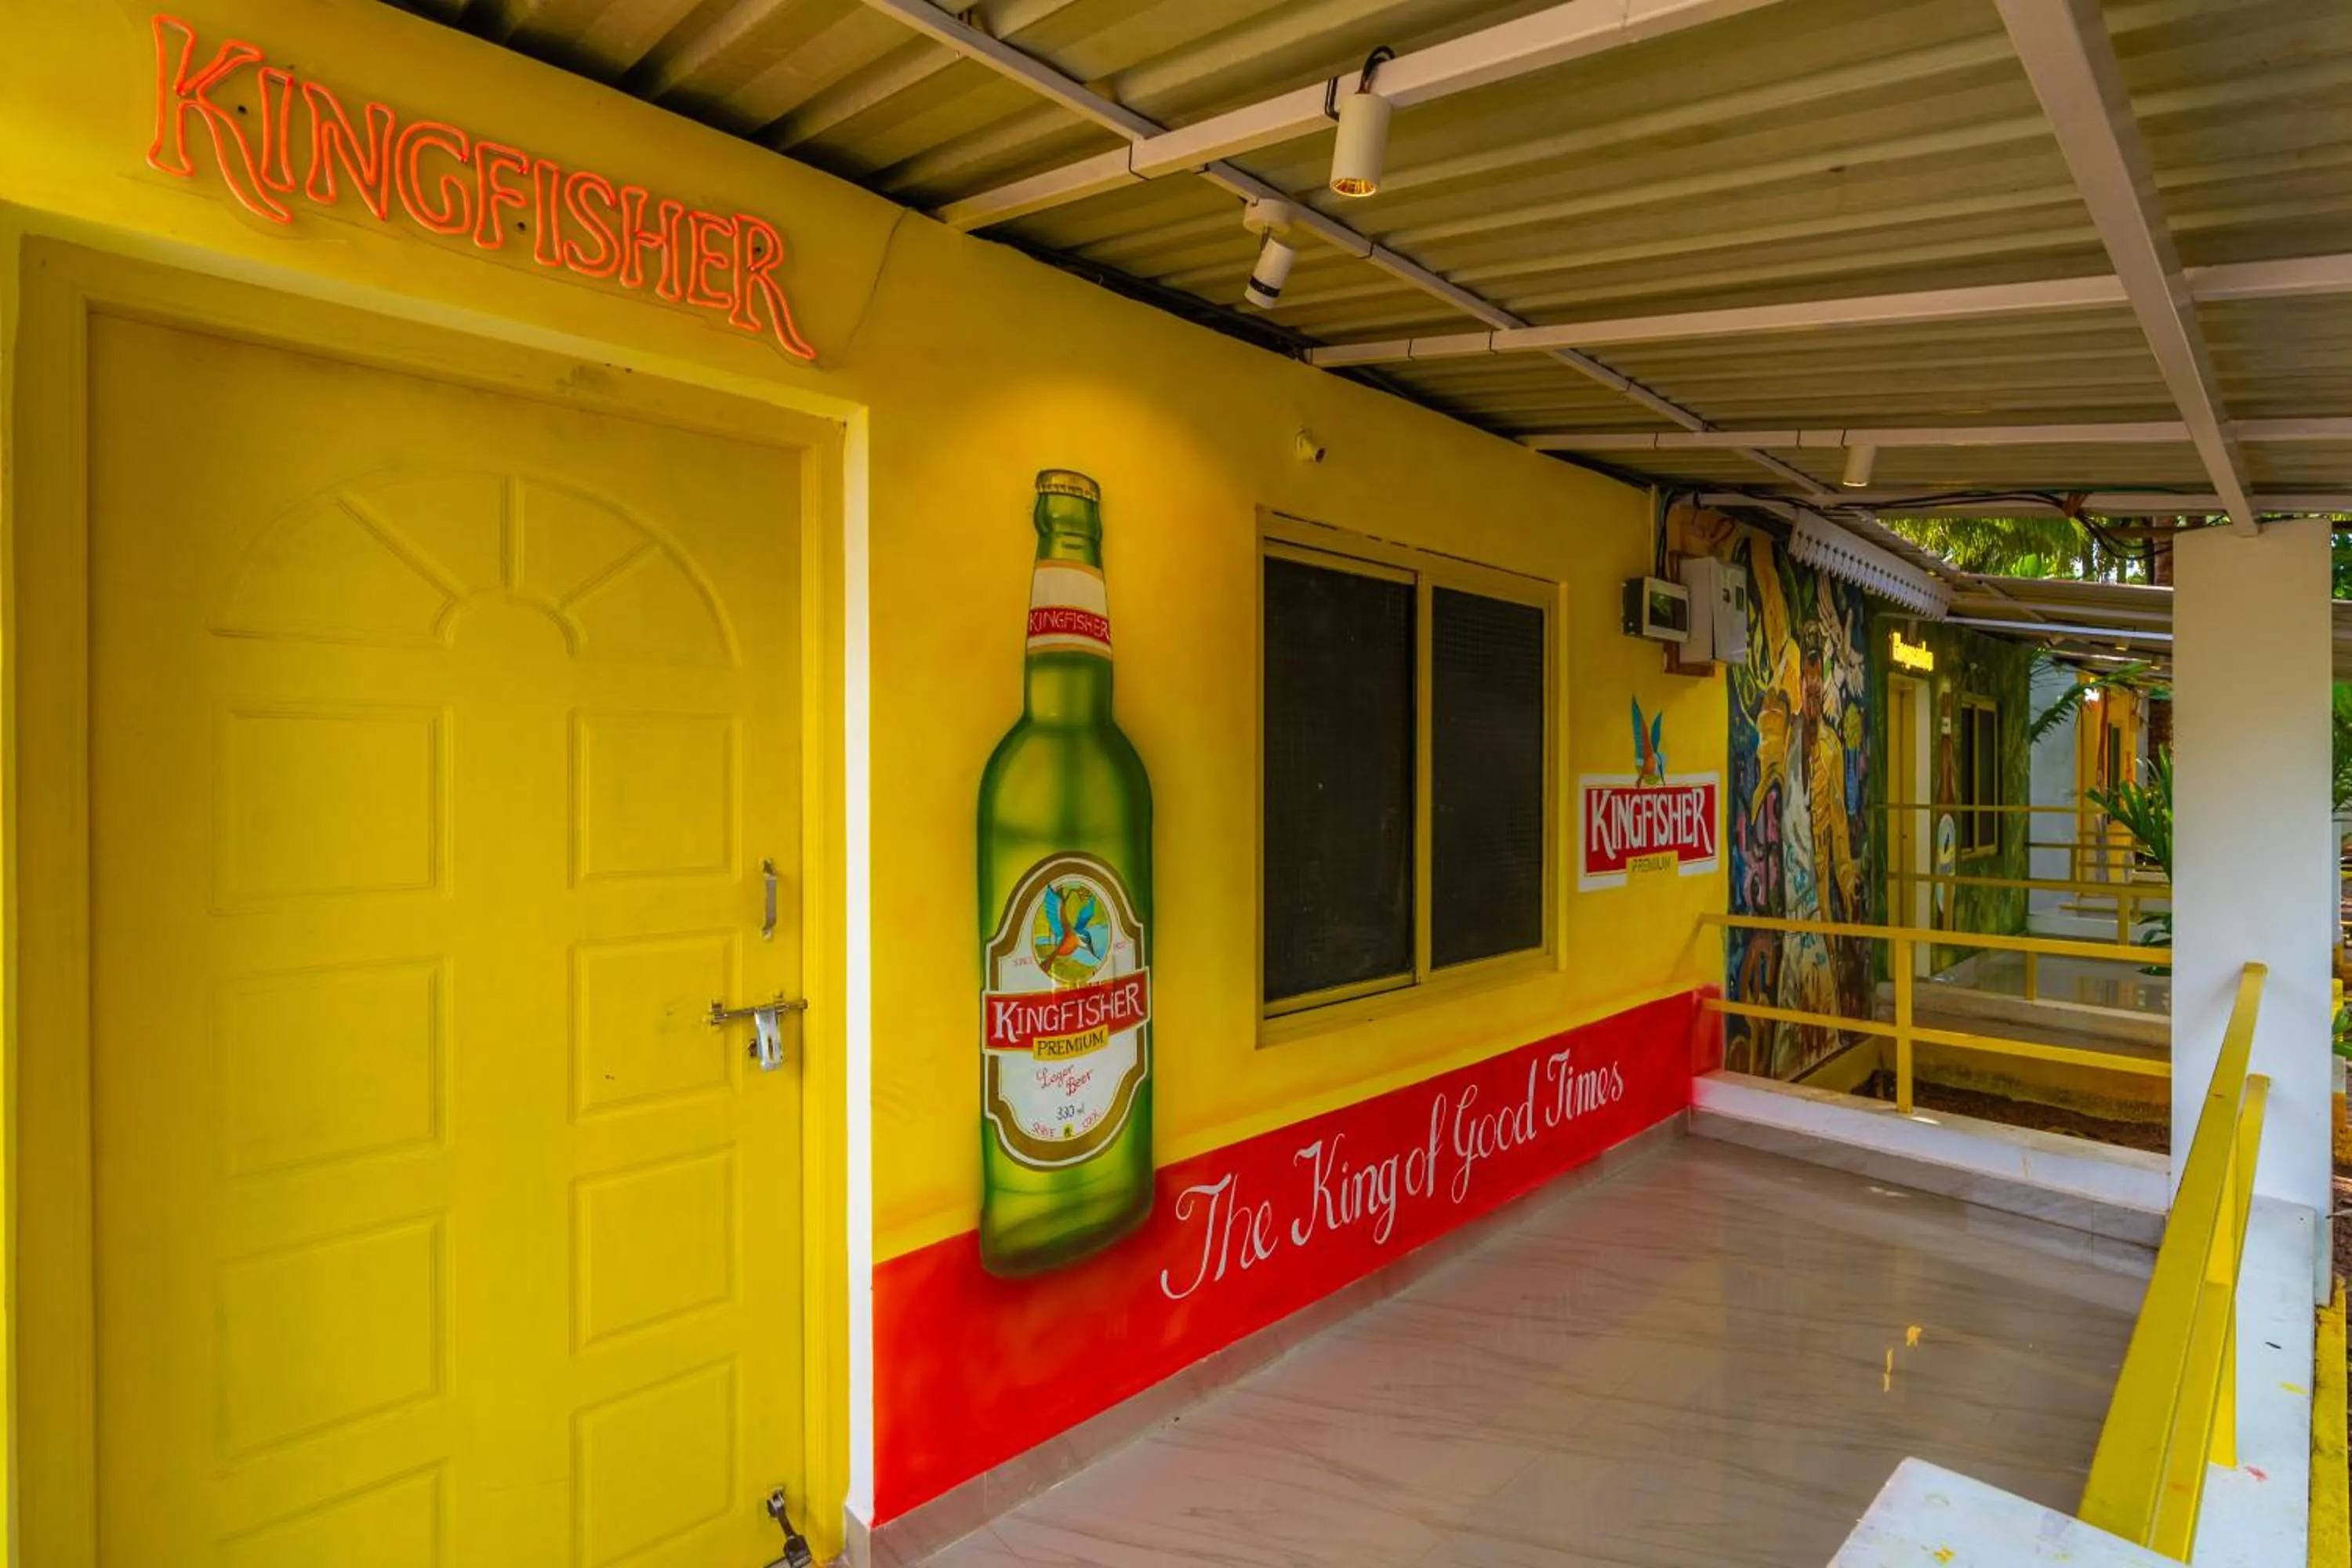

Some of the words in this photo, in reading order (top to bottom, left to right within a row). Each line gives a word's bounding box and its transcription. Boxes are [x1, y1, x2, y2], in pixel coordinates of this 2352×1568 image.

[147, 14, 816, 361] KINGFISHER
[1030, 611, 1111, 641] KINGFISHER
[1592, 787, 1713, 860] KINGFISHER
[993, 981, 1145, 1044] KINGFISHER
[1037, 1034, 1104, 1057] PREMIUM
[1055, 1104, 1075, 1121] 330
[1161, 1173, 1279, 1300] The
[1291, 1133, 1399, 1245] King
[1405, 1093, 1446, 1198] of
[1450, 1058, 1536, 1204] Good
[1545, 1048, 1624, 1127] Times
